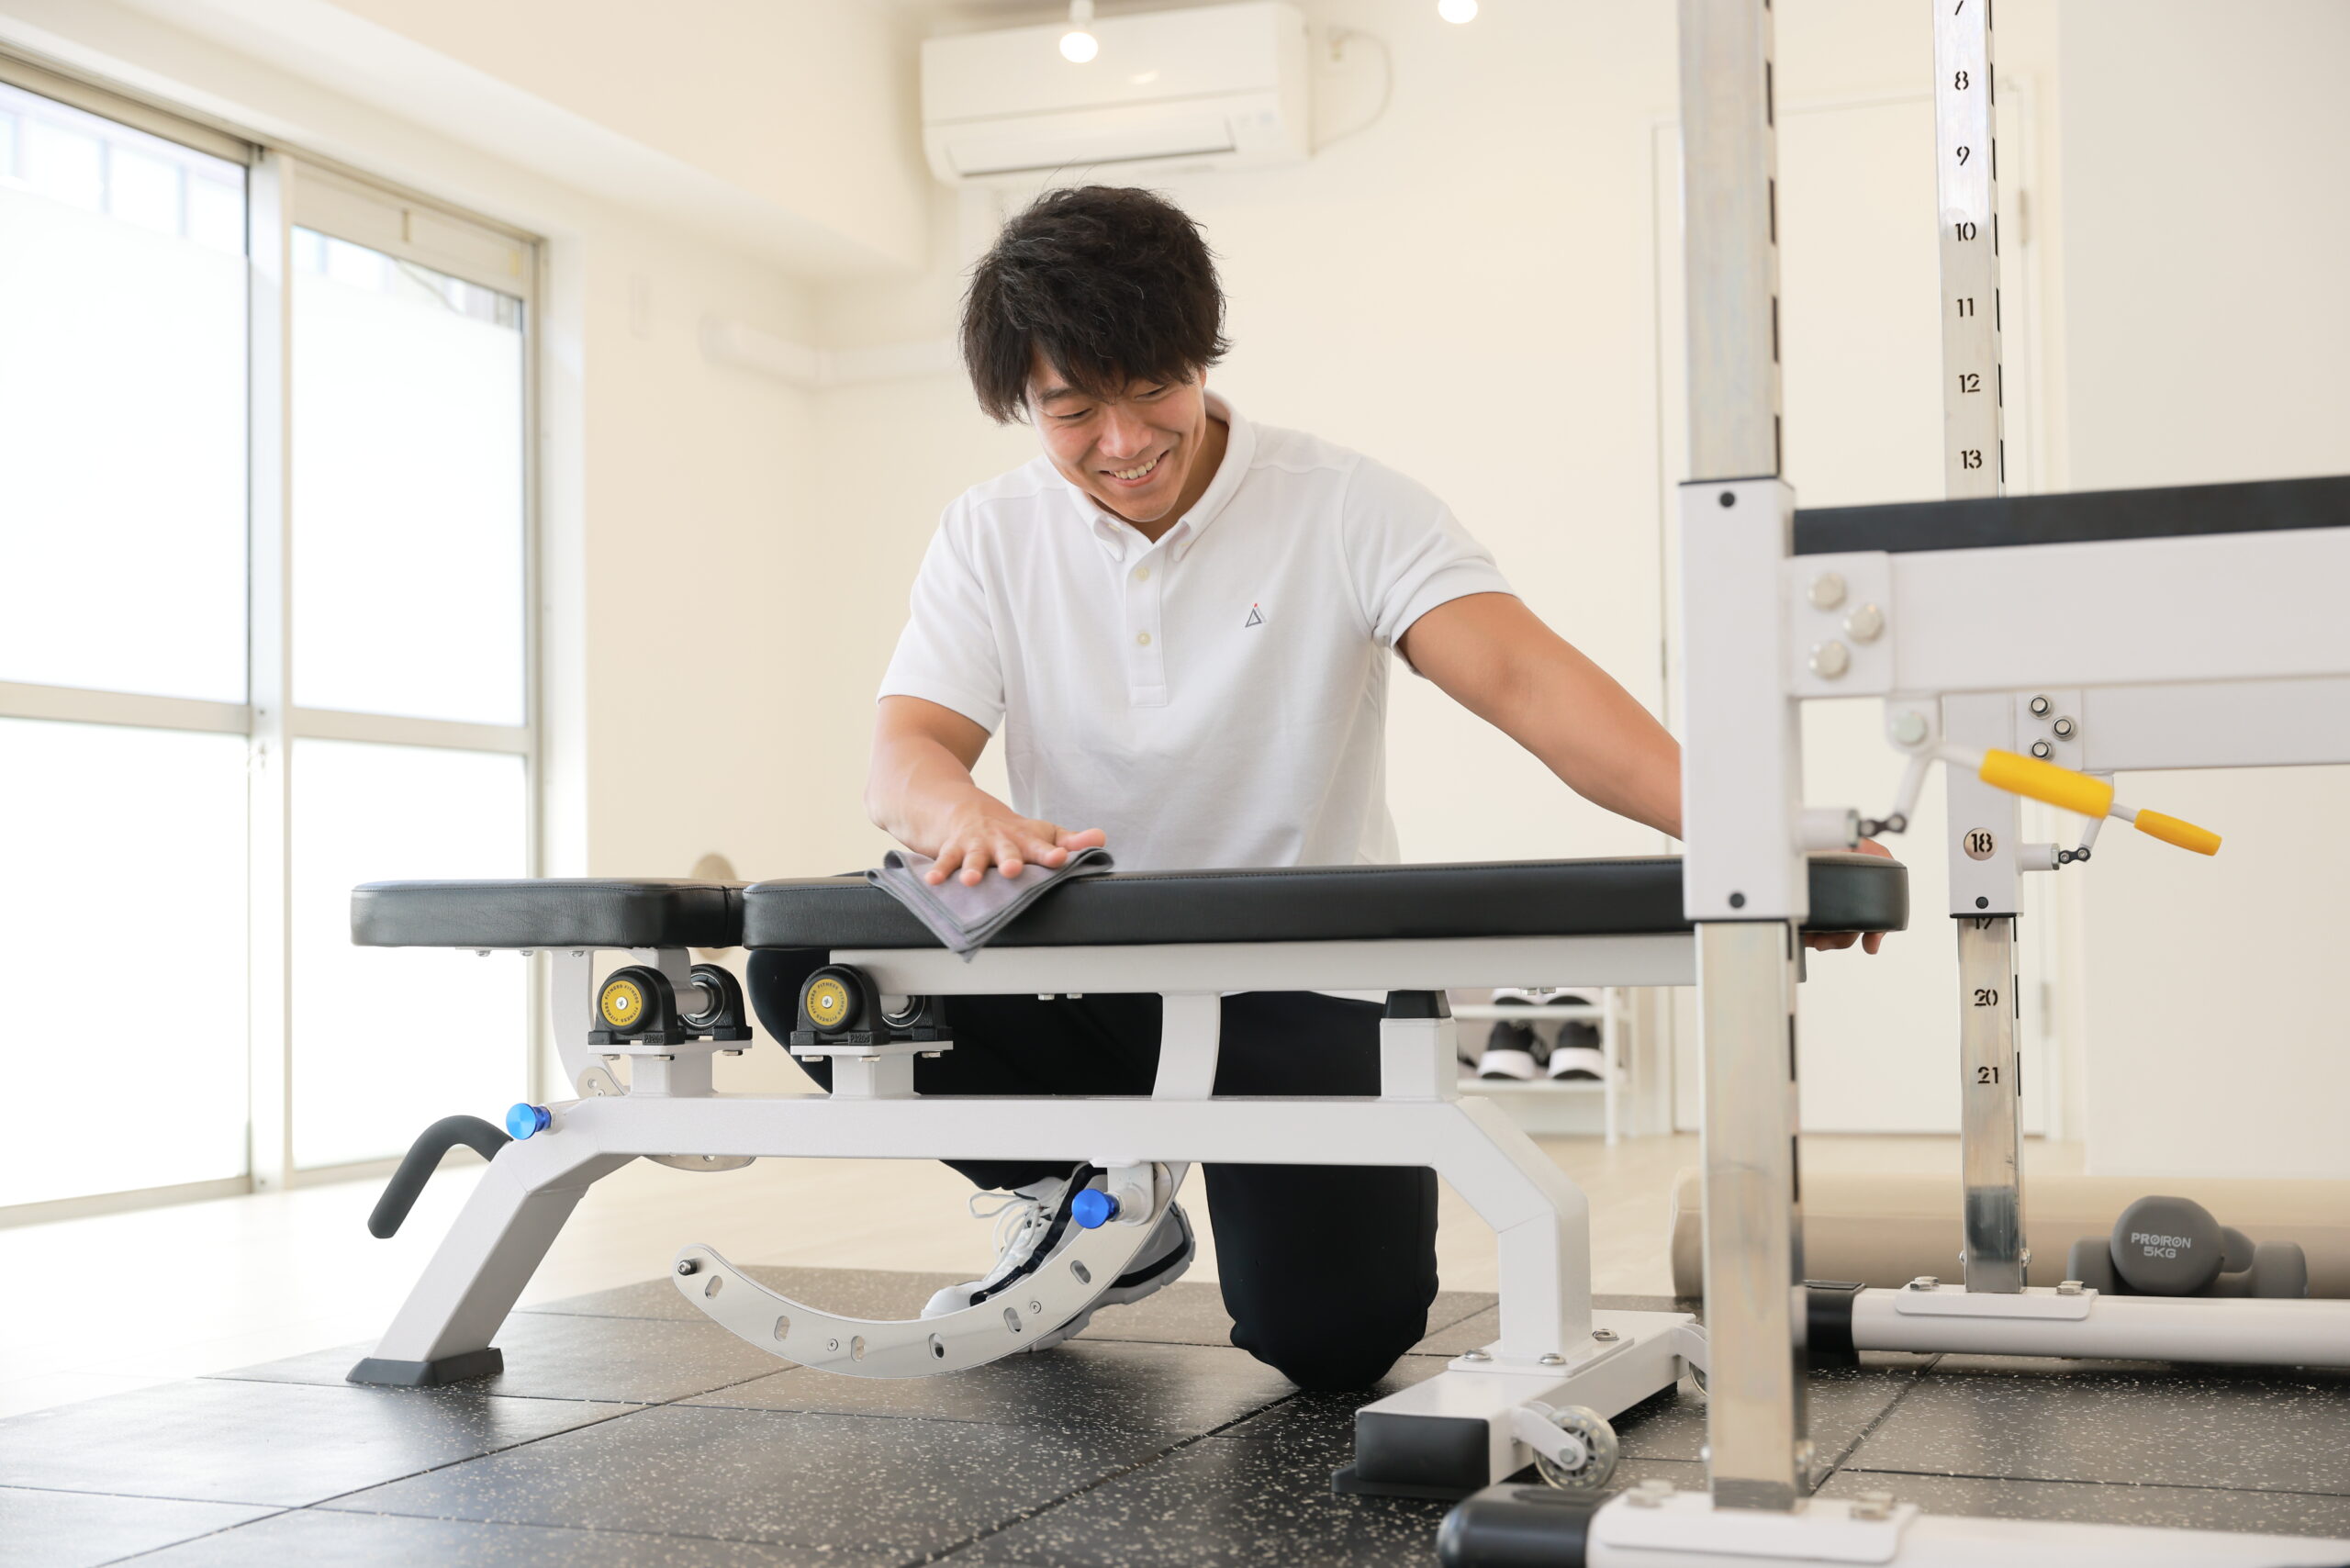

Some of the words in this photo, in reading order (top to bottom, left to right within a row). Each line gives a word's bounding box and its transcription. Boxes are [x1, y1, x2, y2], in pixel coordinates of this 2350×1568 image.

[1954, 71, 1969, 91] 8
[1956, 146, 1970, 166] 9
[1955, 222, 1976, 241] 10
[1957, 297, 1974, 318] 11
[1959, 373, 1981, 393] 12
[1961, 449, 1983, 469] 13
[1971, 833, 1993, 853] 18
[817, 981, 839, 990] FITNESS
[837, 991, 845, 1015] FITNESS
[1974, 989, 1998, 1007] 20
[816, 1014, 838, 1023] FITNESS
[1977, 1066, 1999, 1084] 21
[2131, 1232, 2192, 1249] PROIRON
[2143, 1246, 2177, 1259] 5KG
